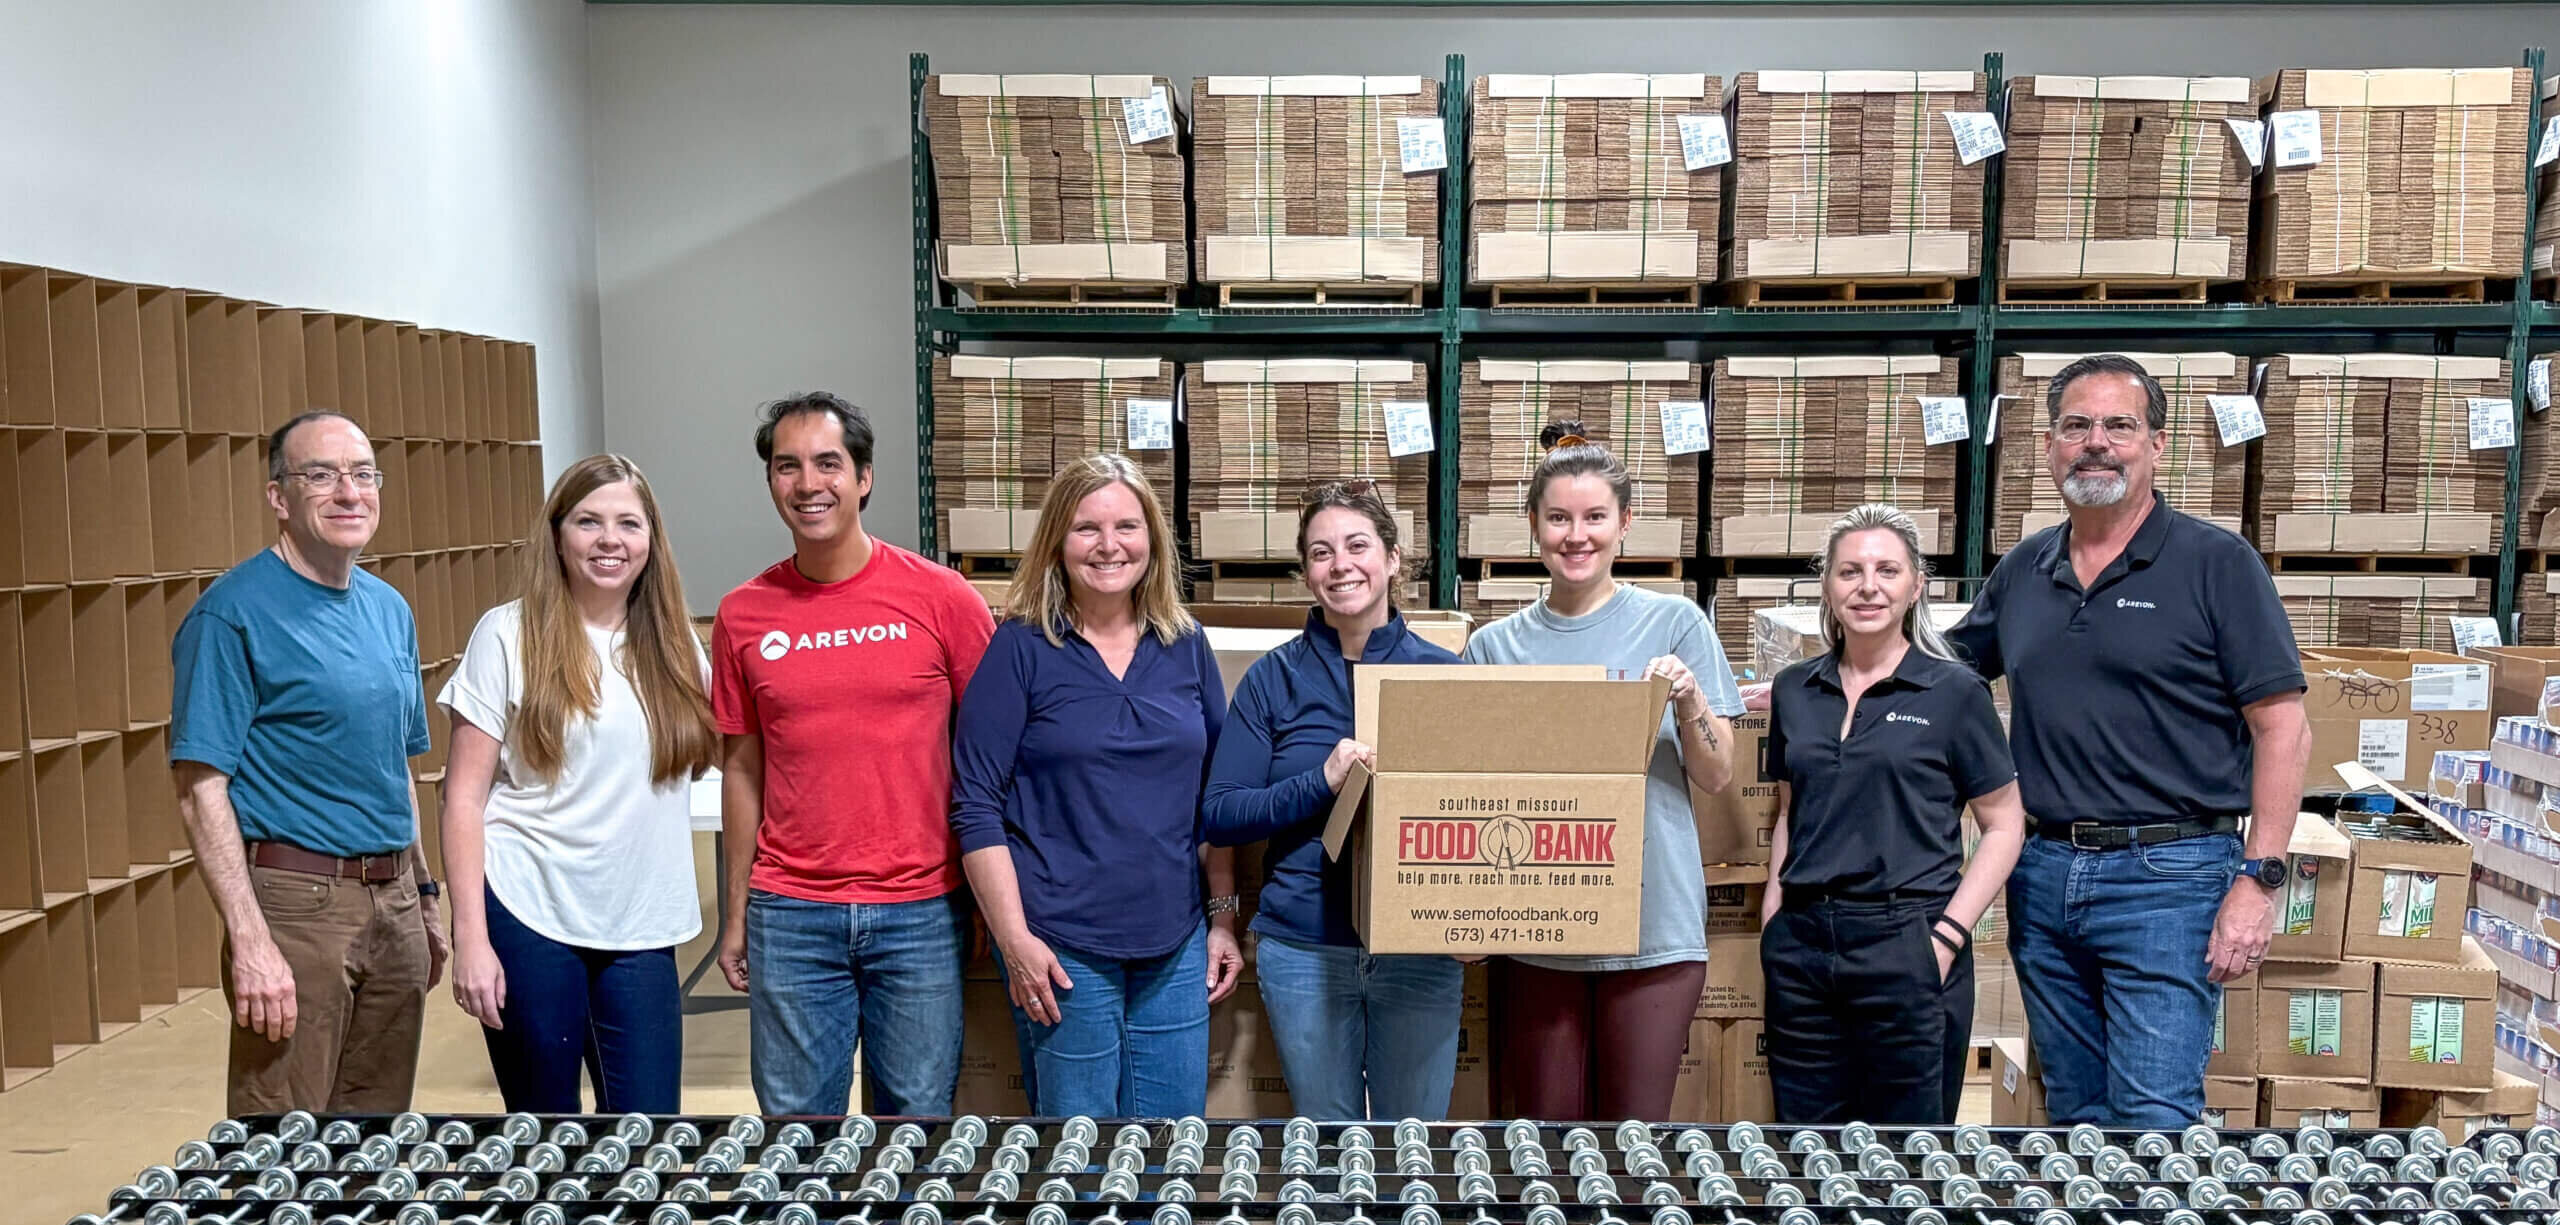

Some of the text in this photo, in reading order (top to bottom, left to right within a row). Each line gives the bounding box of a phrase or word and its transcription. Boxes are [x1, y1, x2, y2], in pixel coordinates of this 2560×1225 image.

[795, 622, 907, 651] AREVON
[1733, 718, 1767, 729] STORE
[1439, 796, 1578, 811] southeast missouri
[1399, 822, 1616, 862] FOOD BANK
[1398, 871, 1614, 887] help more. reach more. feed more.
[1410, 906, 1599, 925] www.semofoodbank.org
[1444, 927, 1564, 944] (573) 471-1818
